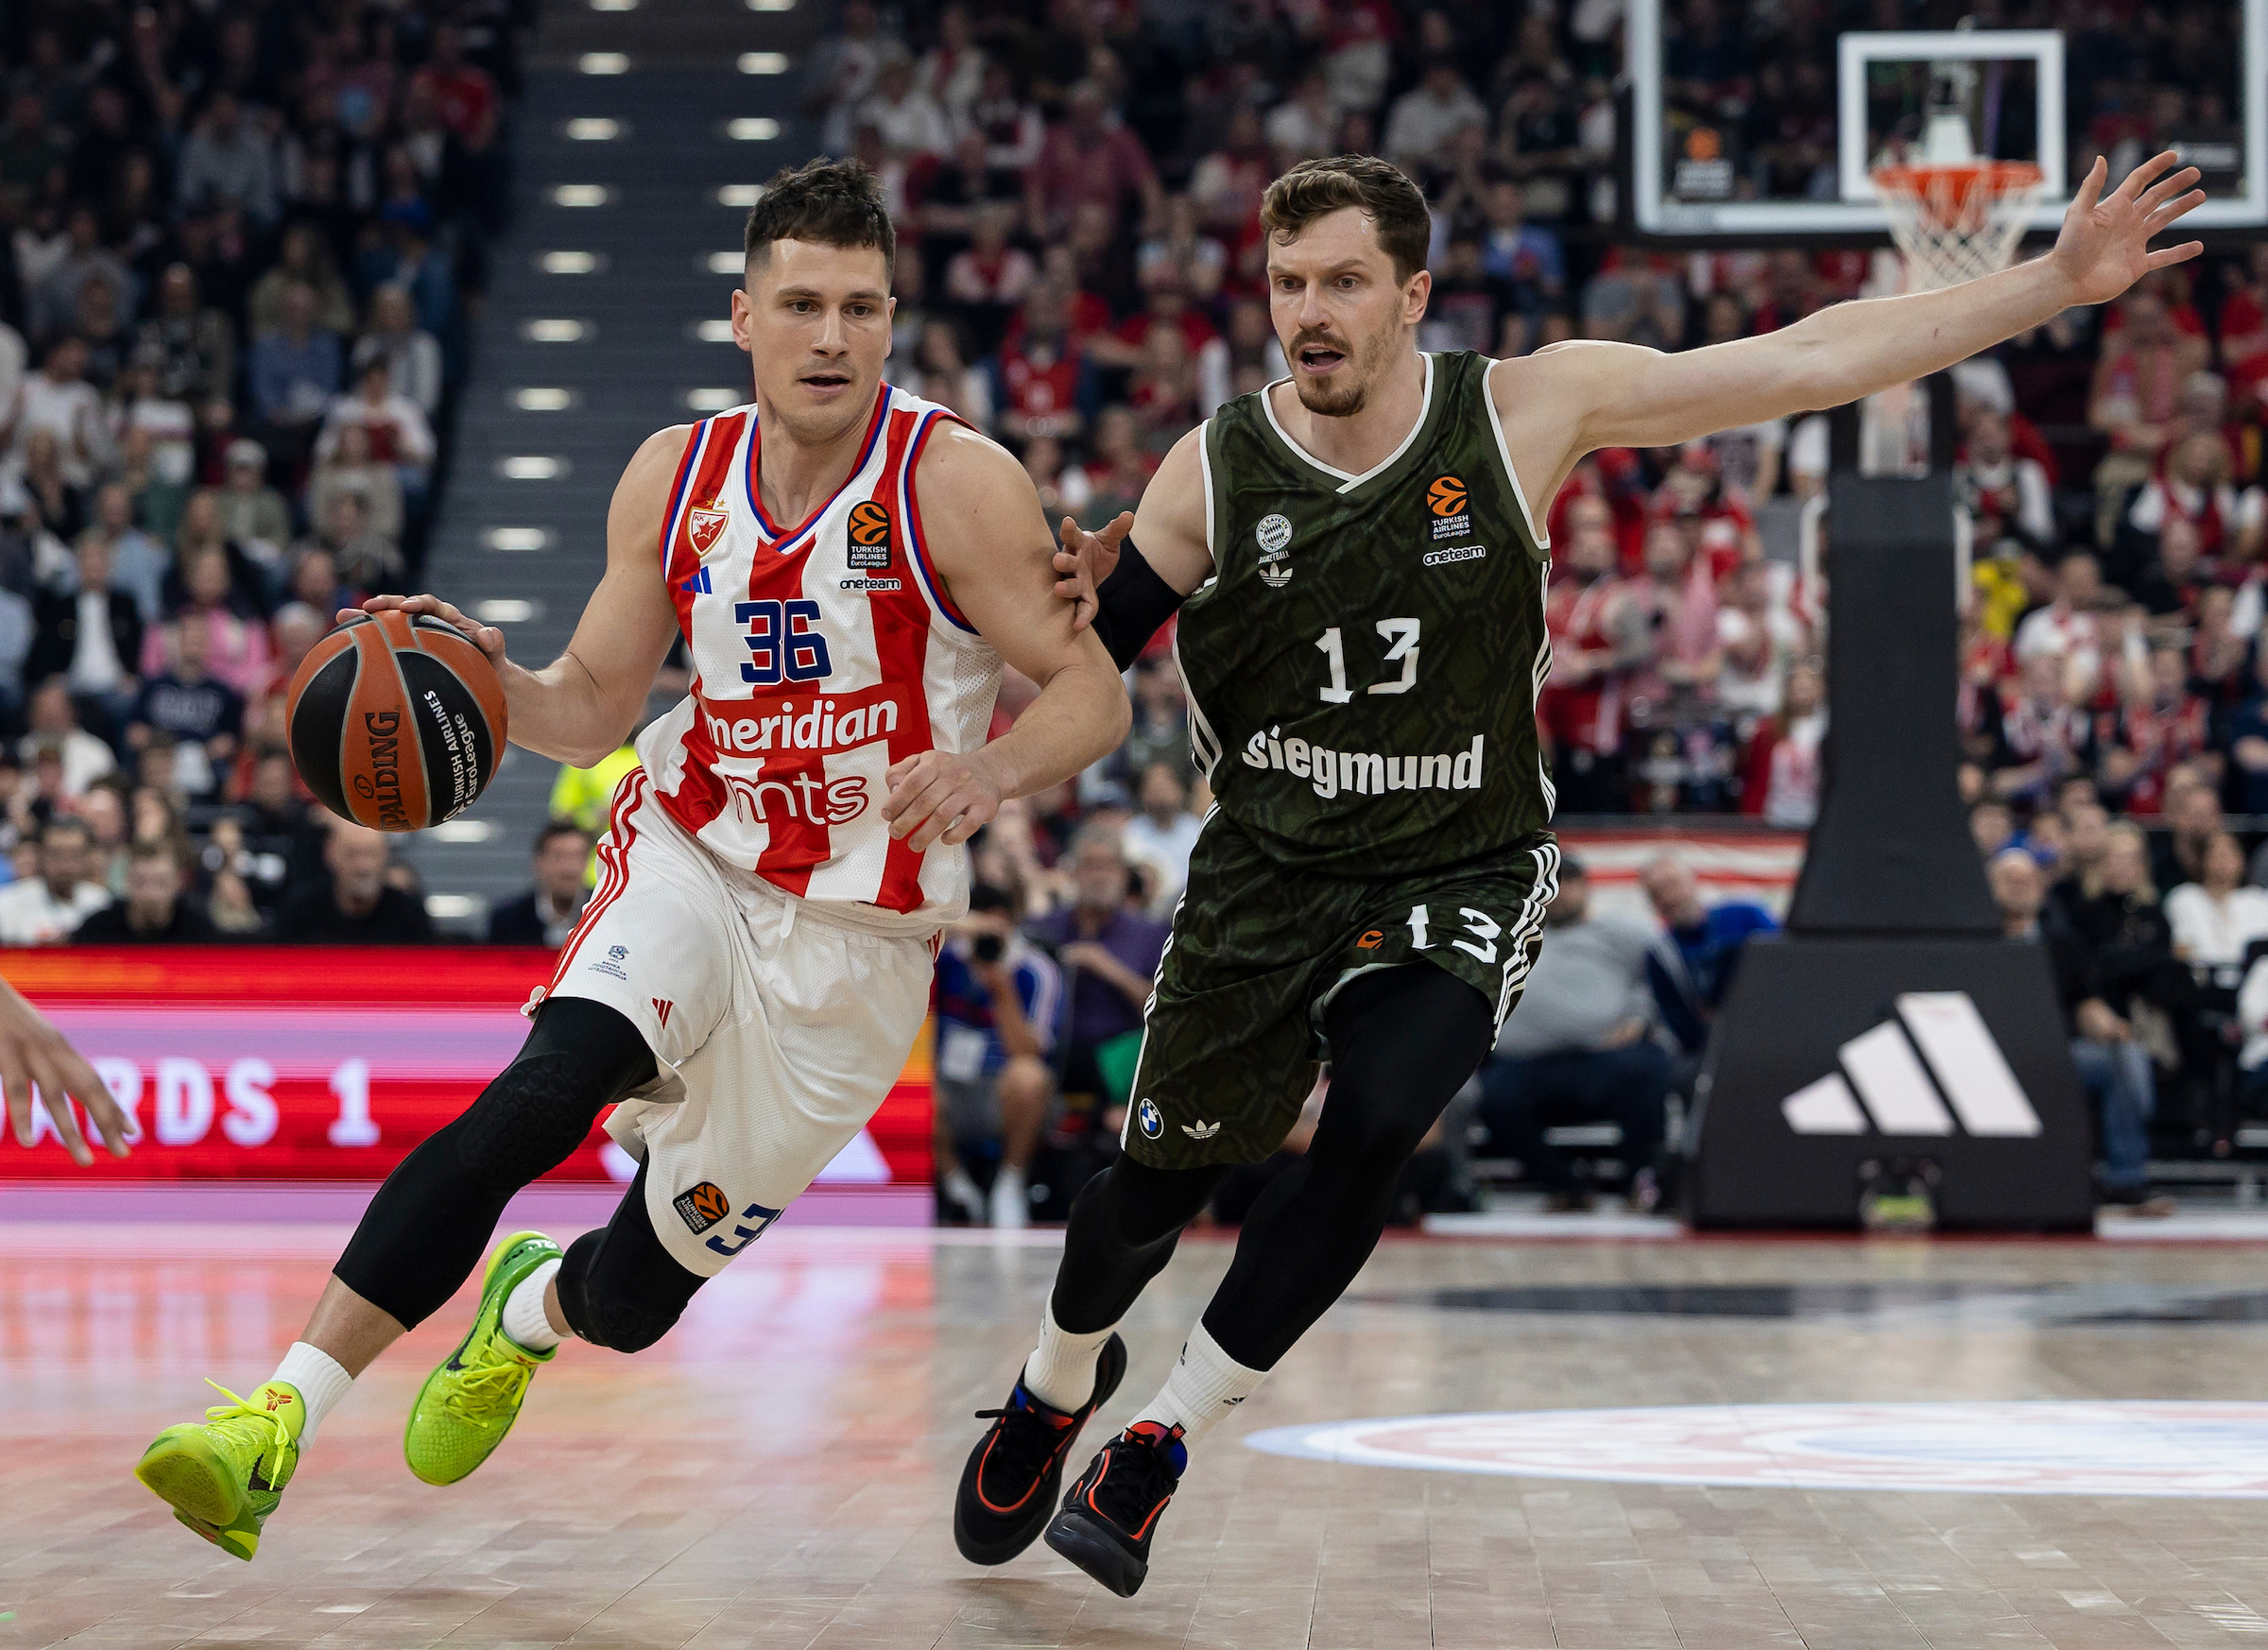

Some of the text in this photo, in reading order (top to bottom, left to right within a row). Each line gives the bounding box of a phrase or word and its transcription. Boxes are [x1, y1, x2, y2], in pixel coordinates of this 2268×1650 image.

[1432, 514, 1469, 526] TURKISH
[1433, 521, 1470, 534] AIRLINES
[1433, 529, 1470, 540] EuroLeague
[850, 545, 887, 554] TURKISH
[850, 559, 887, 568] EuroLeague
[1423, 545, 1486, 566] oneteam
[840, 576, 902, 591] oneteam
[733, 598, 833, 684] 36
[1314, 617, 1420, 704] 13
[423, 690, 465, 805] TURKISH AIRLINES
[705, 699, 899, 752] meridian
[365, 712, 415, 831] PALDING
[455, 713, 478, 799] EuroLeague
[1241, 725, 1485, 799] siegmund
[724, 771, 870, 826] mts
[1405, 903, 1502, 964] 13
[328, 1057, 381, 1146] 1
